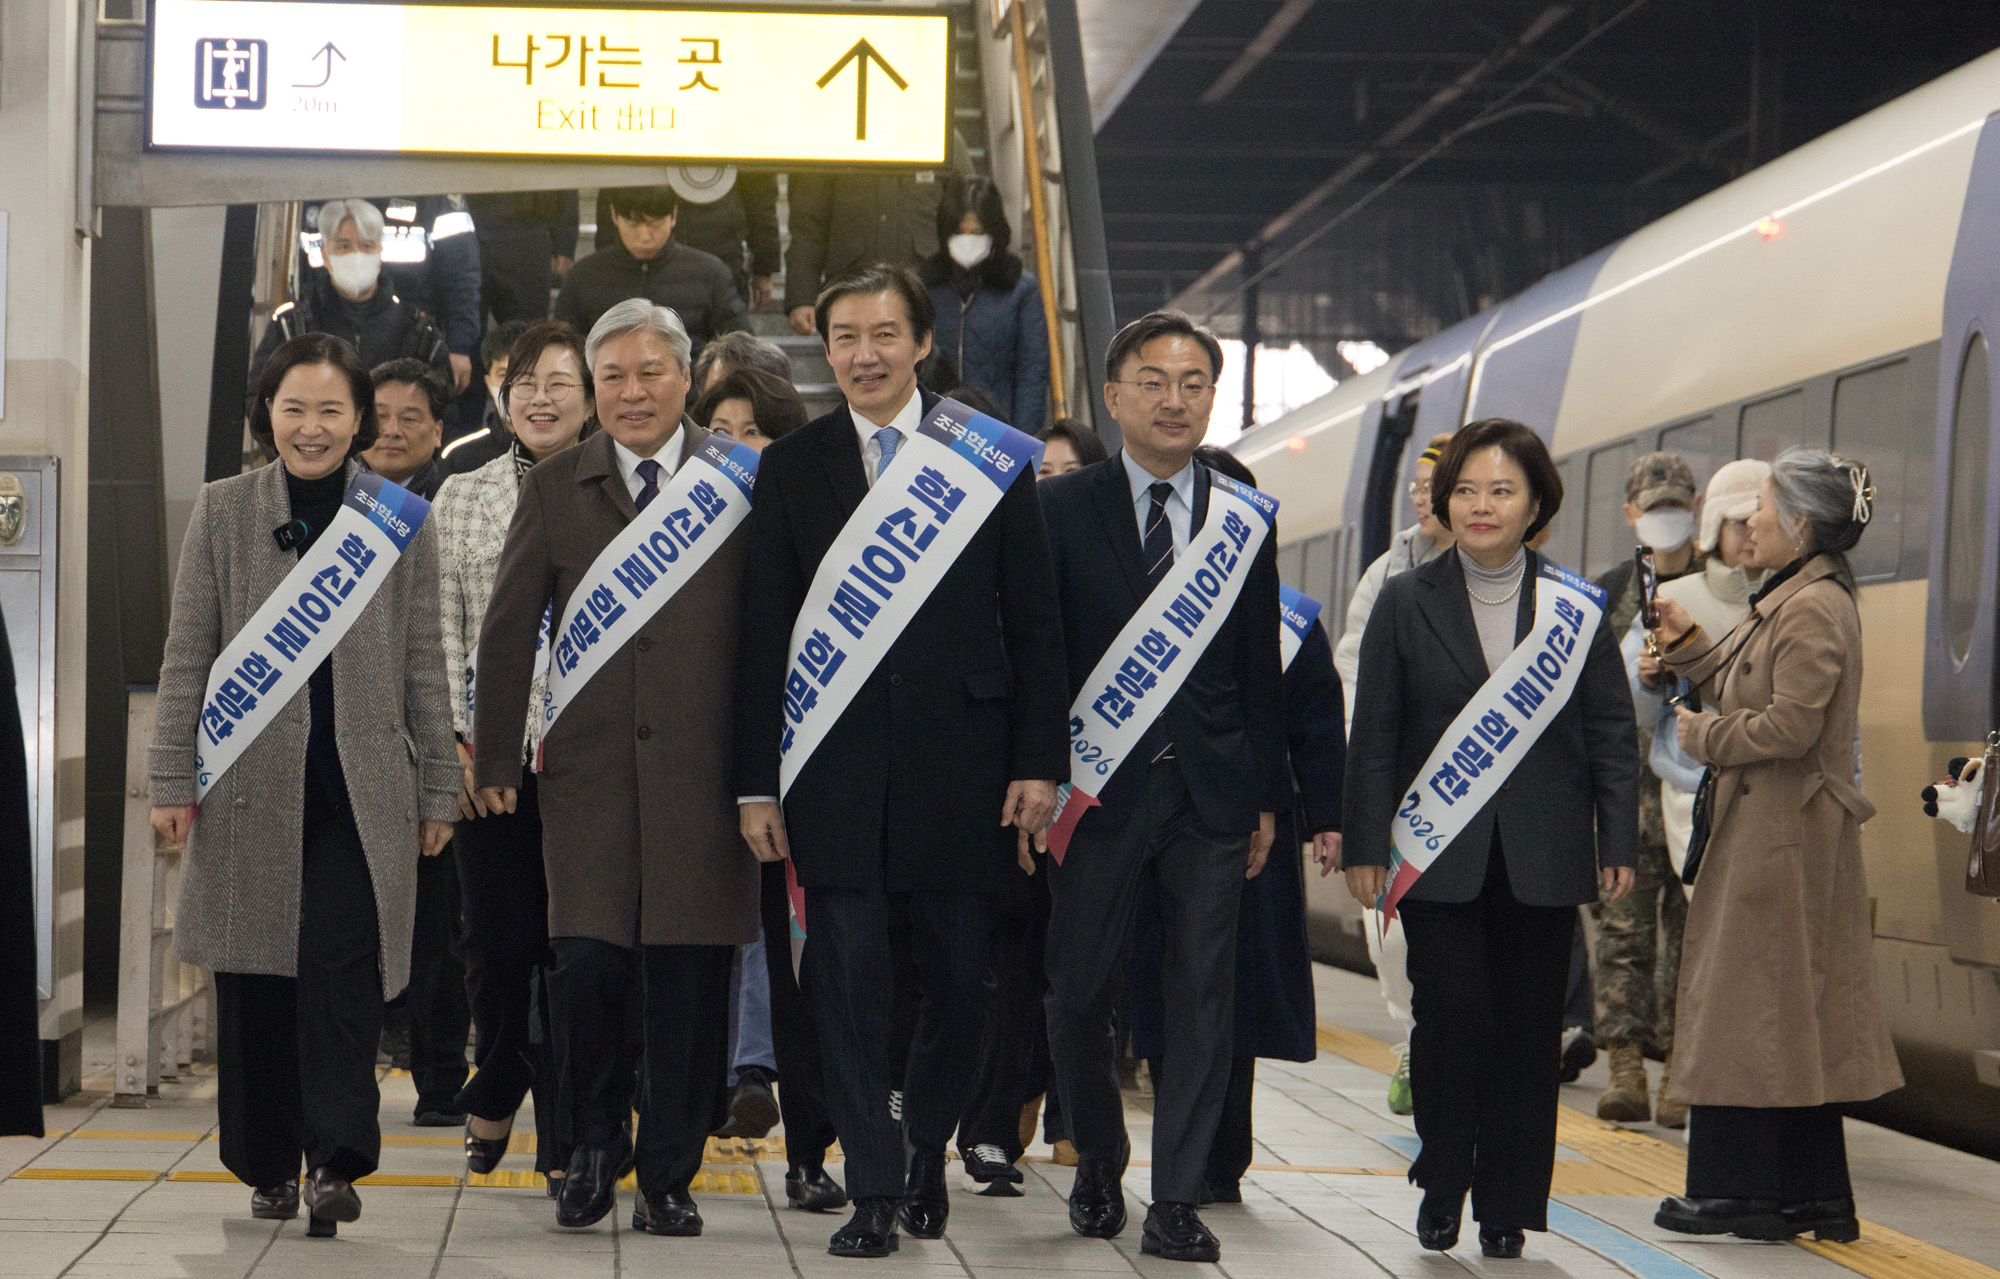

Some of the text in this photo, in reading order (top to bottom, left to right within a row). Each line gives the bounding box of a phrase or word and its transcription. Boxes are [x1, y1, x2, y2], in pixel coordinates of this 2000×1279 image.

[492, 34, 722, 91] 나가는 곳
[293, 96, 337, 112] 20m
[538, 100, 674, 131] Exit 出口
[933, 413, 1015, 474] 조국혁신당
[354, 488, 411, 538] 조국혁신당
[1217, 474, 1275, 514] 조국혁신당
[555, 478, 728, 679] 혁신으로 희망찬
[827, 465, 967, 640] 혁신으로
[1543, 563, 1602, 598] 조국혁신당
[200, 531, 377, 747] 혁신으로 희망찬
[1091, 508, 1252, 729] 혁신으로 희망찬
[1429, 595, 1585, 807] 혁신으로 희망찬
[1398, 789, 1447, 851] 2026
